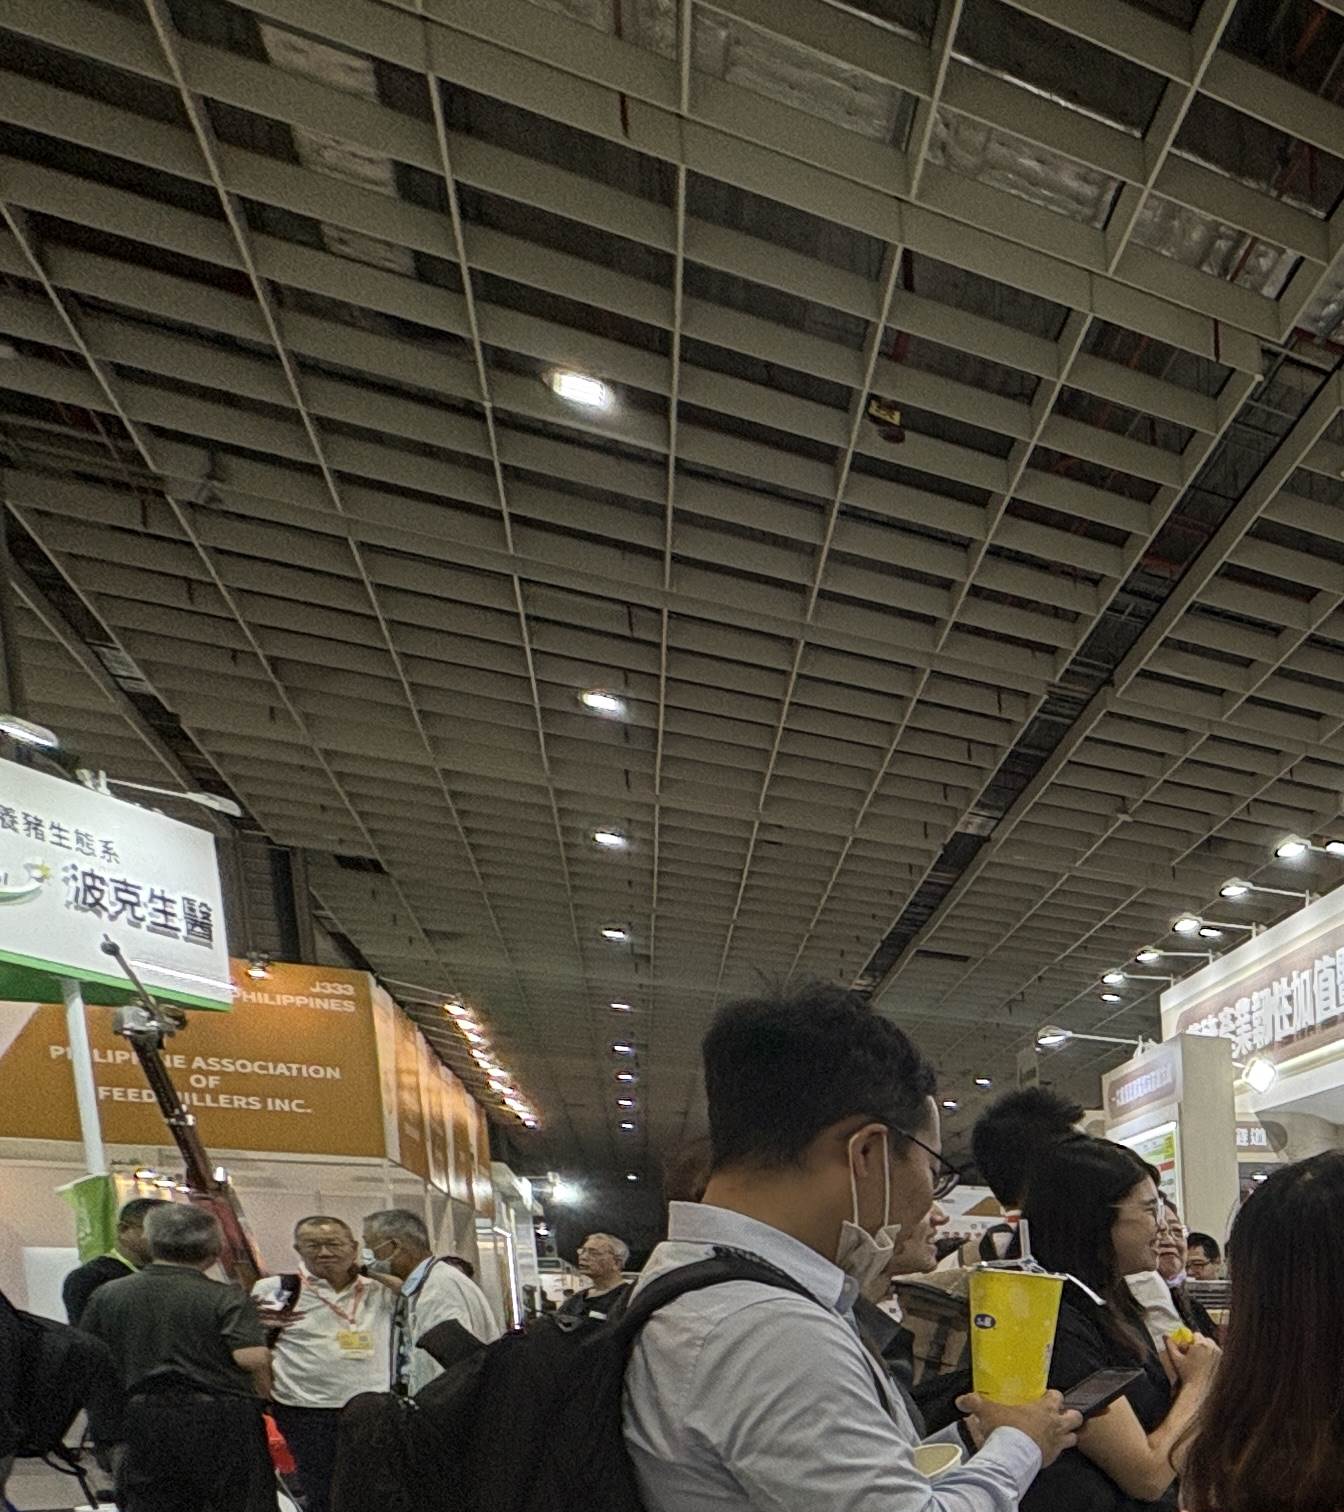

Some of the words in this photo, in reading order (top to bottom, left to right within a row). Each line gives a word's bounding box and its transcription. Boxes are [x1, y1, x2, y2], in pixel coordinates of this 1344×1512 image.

[70, 864, 213, 944] 波克生醫
[310, 981, 355, 995] J333
[192, 1056, 341, 1079] ASSOCIATION
[189, 1074, 221, 1088] OF
[98, 1086, 157, 1102] FEED
[177, 1090, 262, 1110] ILLERS
[267, 1097, 313, 1113] INC.
